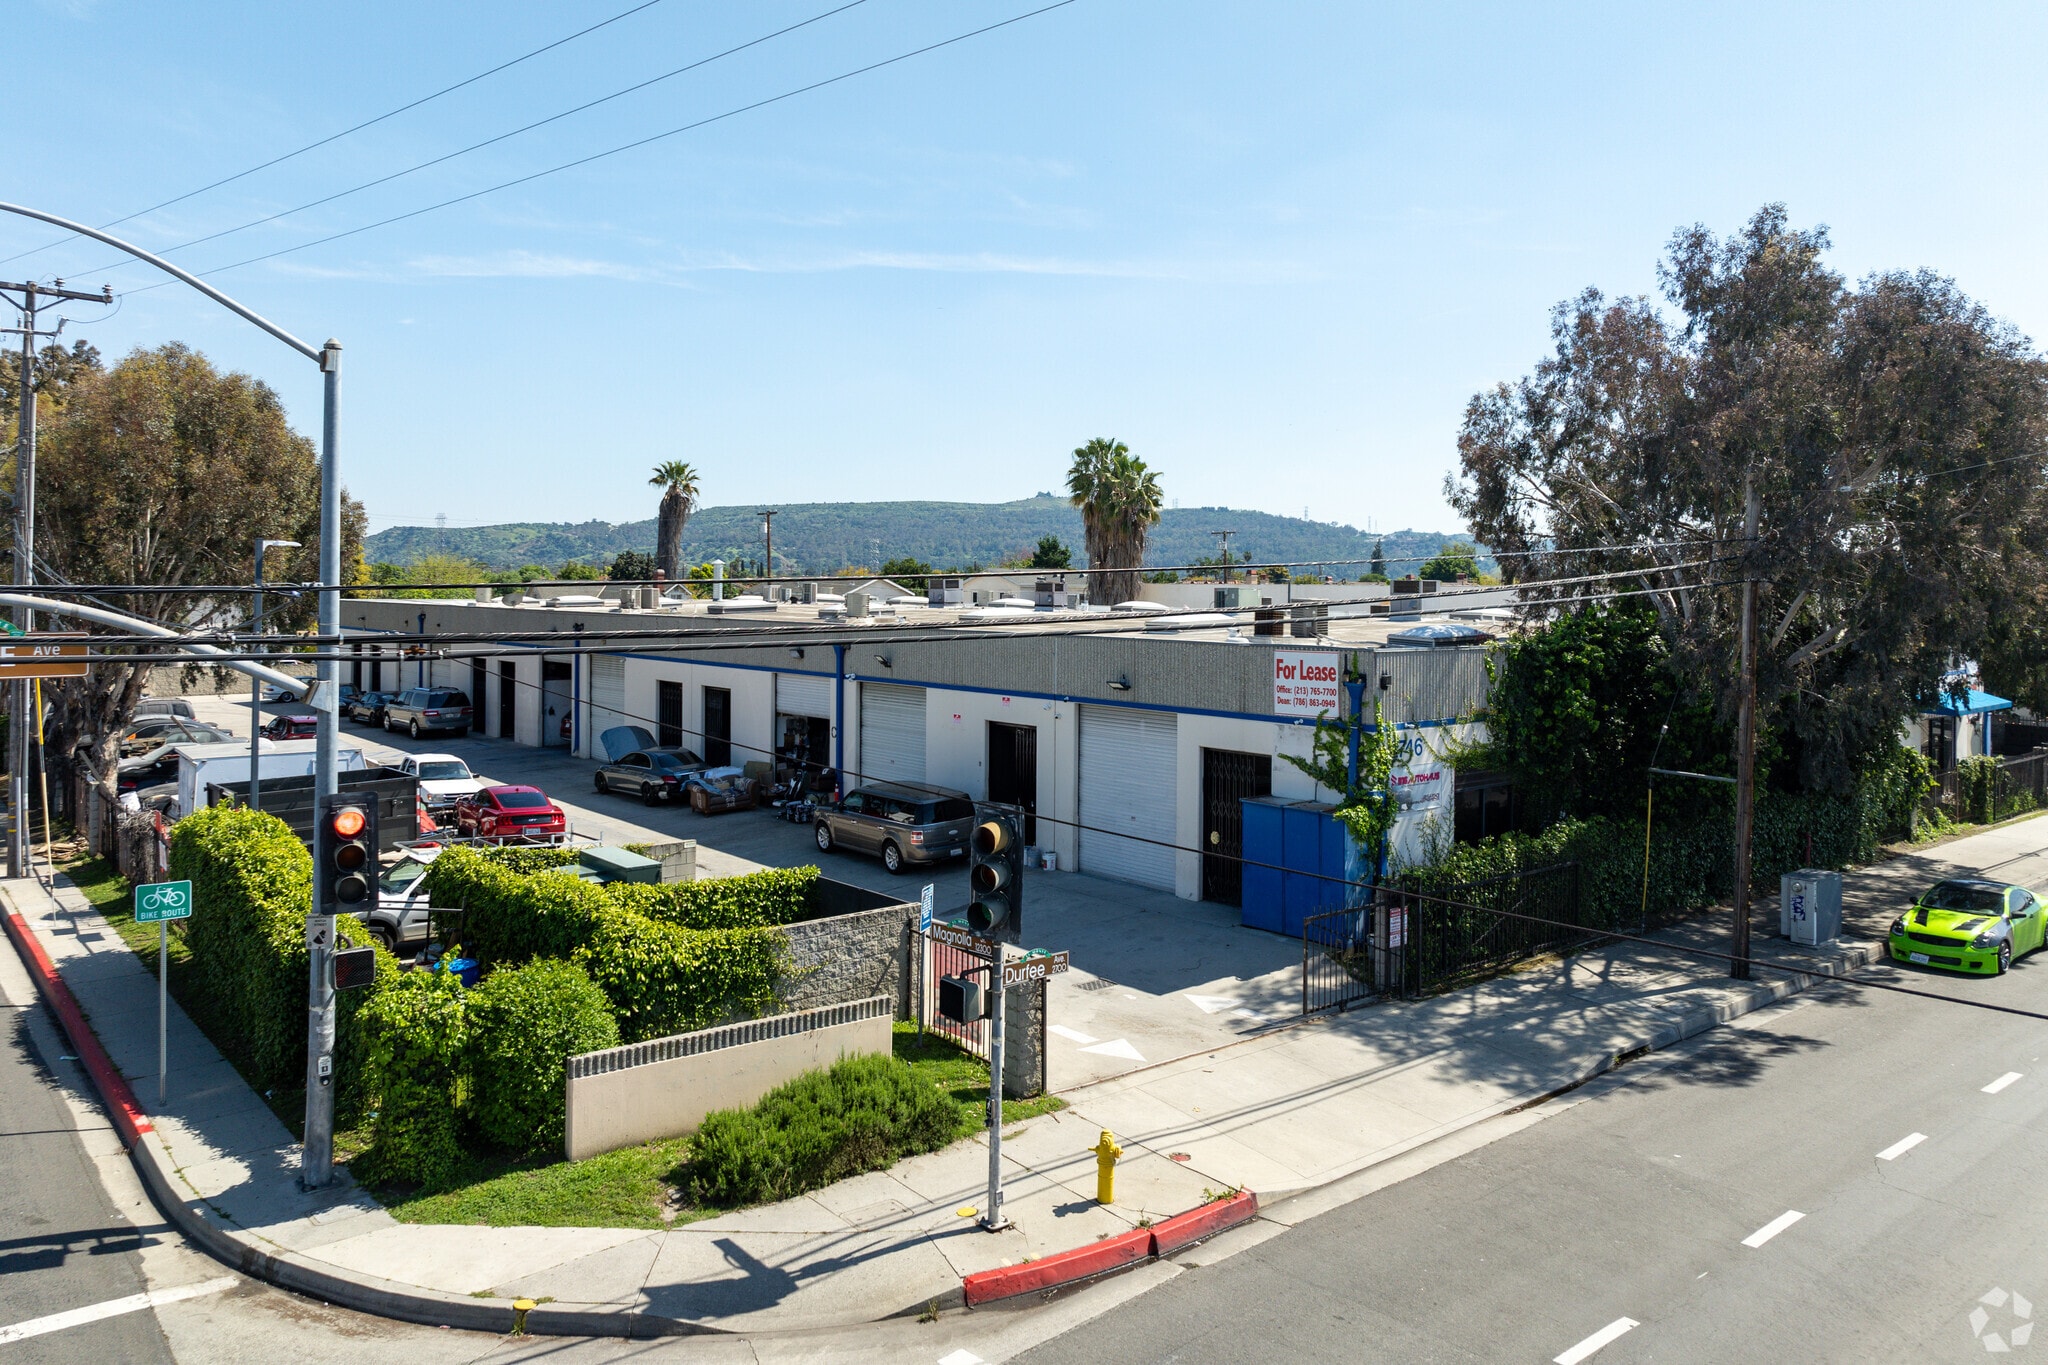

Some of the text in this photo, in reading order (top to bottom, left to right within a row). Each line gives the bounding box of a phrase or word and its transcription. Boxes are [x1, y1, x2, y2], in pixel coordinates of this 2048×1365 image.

[33, 645, 61, 656] Ave
[1276, 658, 1337, 683] For Lease
[1276, 685, 1337, 697] Office: (213) 765-7700
[1293, 697, 1308, 708] (786)
[1309, 698, 1336, 708] 863-0949
[140, 907, 187, 920] BIKE ROUTE
[932, 924, 973, 947] Magnolia
[974, 942, 992, 956] 12300
[1053, 955, 1066, 964] Ave.
[1005, 963, 1046, 984] Durfee
[1051, 963, 1067, 973] 2700
